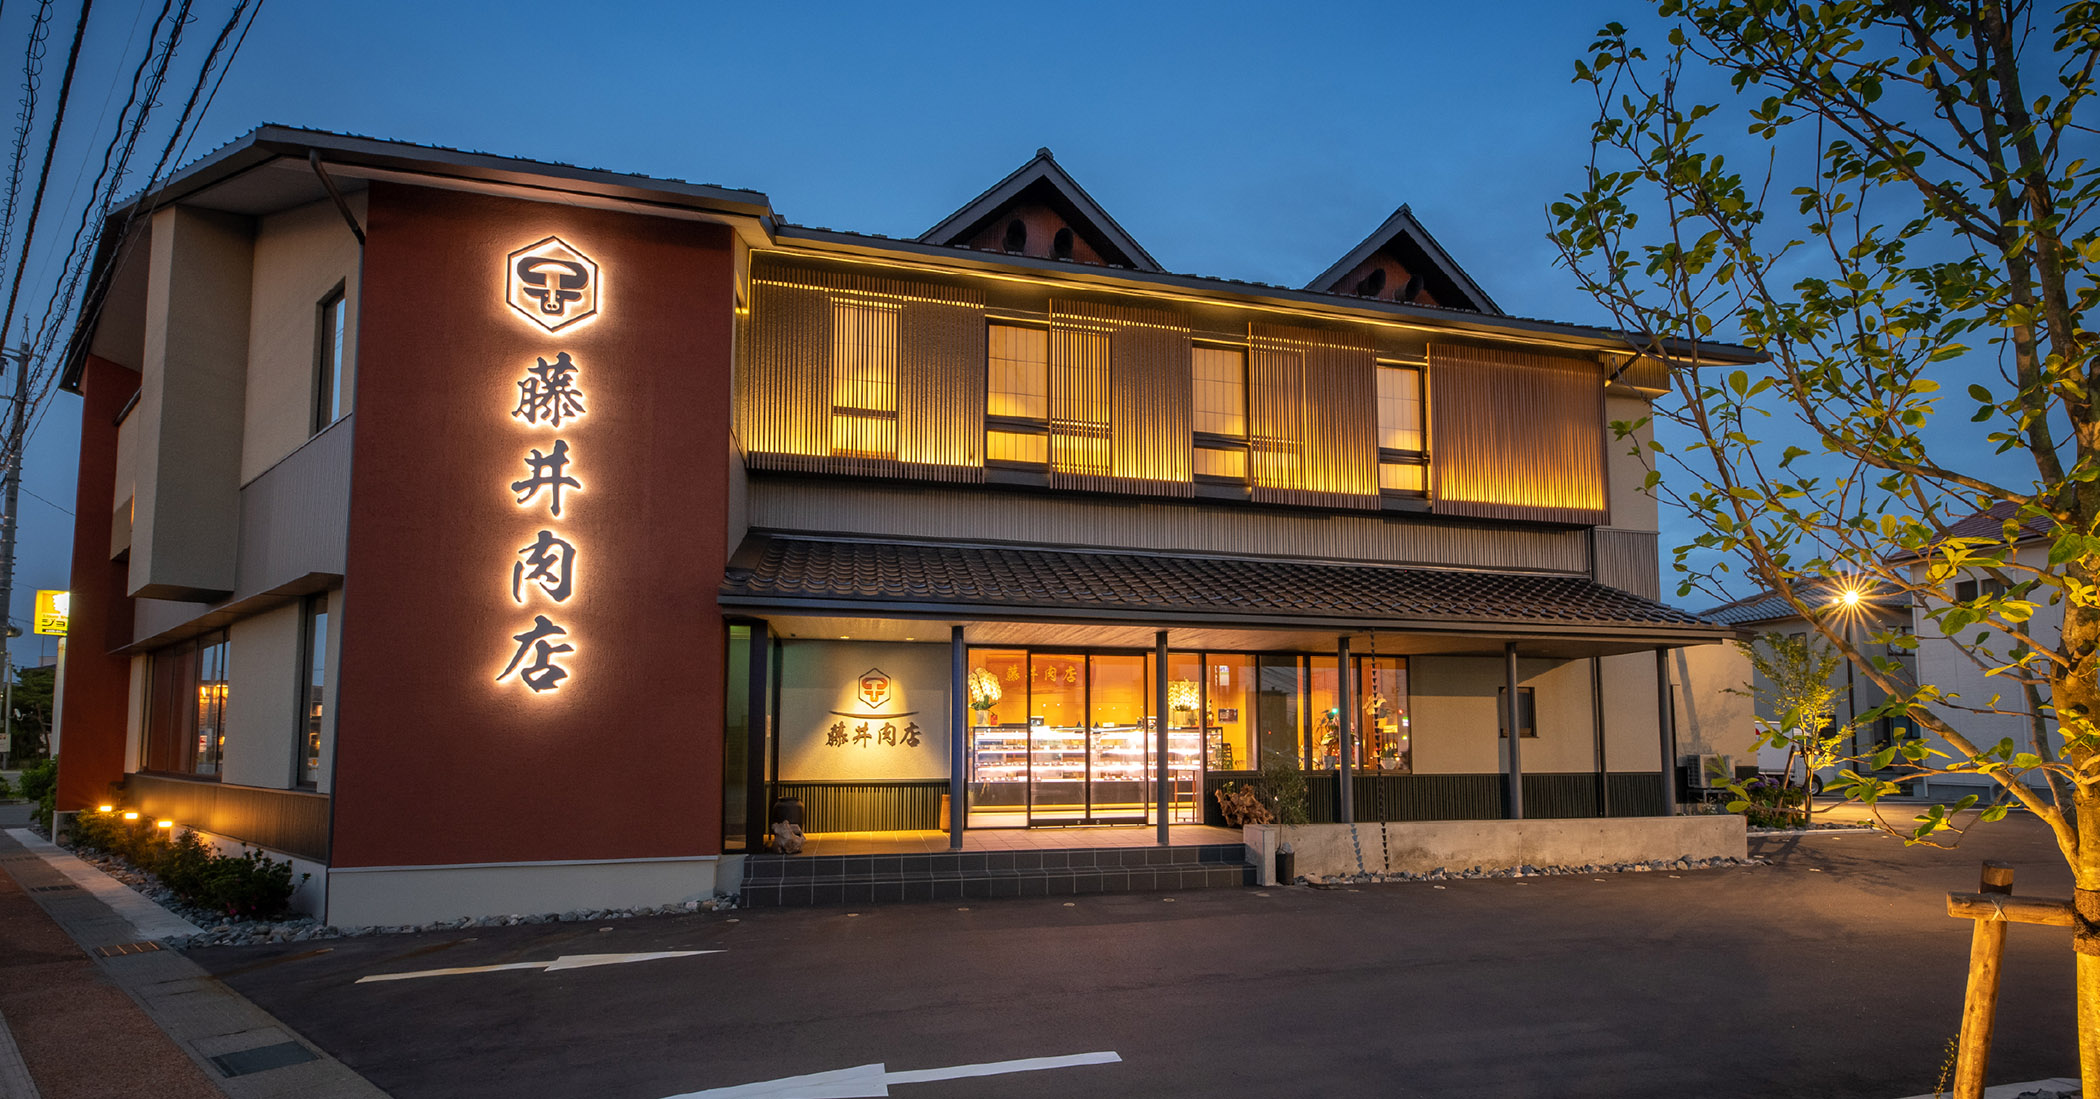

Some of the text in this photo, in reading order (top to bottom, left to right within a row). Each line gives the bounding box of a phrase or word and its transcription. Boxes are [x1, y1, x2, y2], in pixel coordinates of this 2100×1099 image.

[496, 352, 586, 693] 藤井肉店
[825, 721, 922, 748] 藤井肉店
